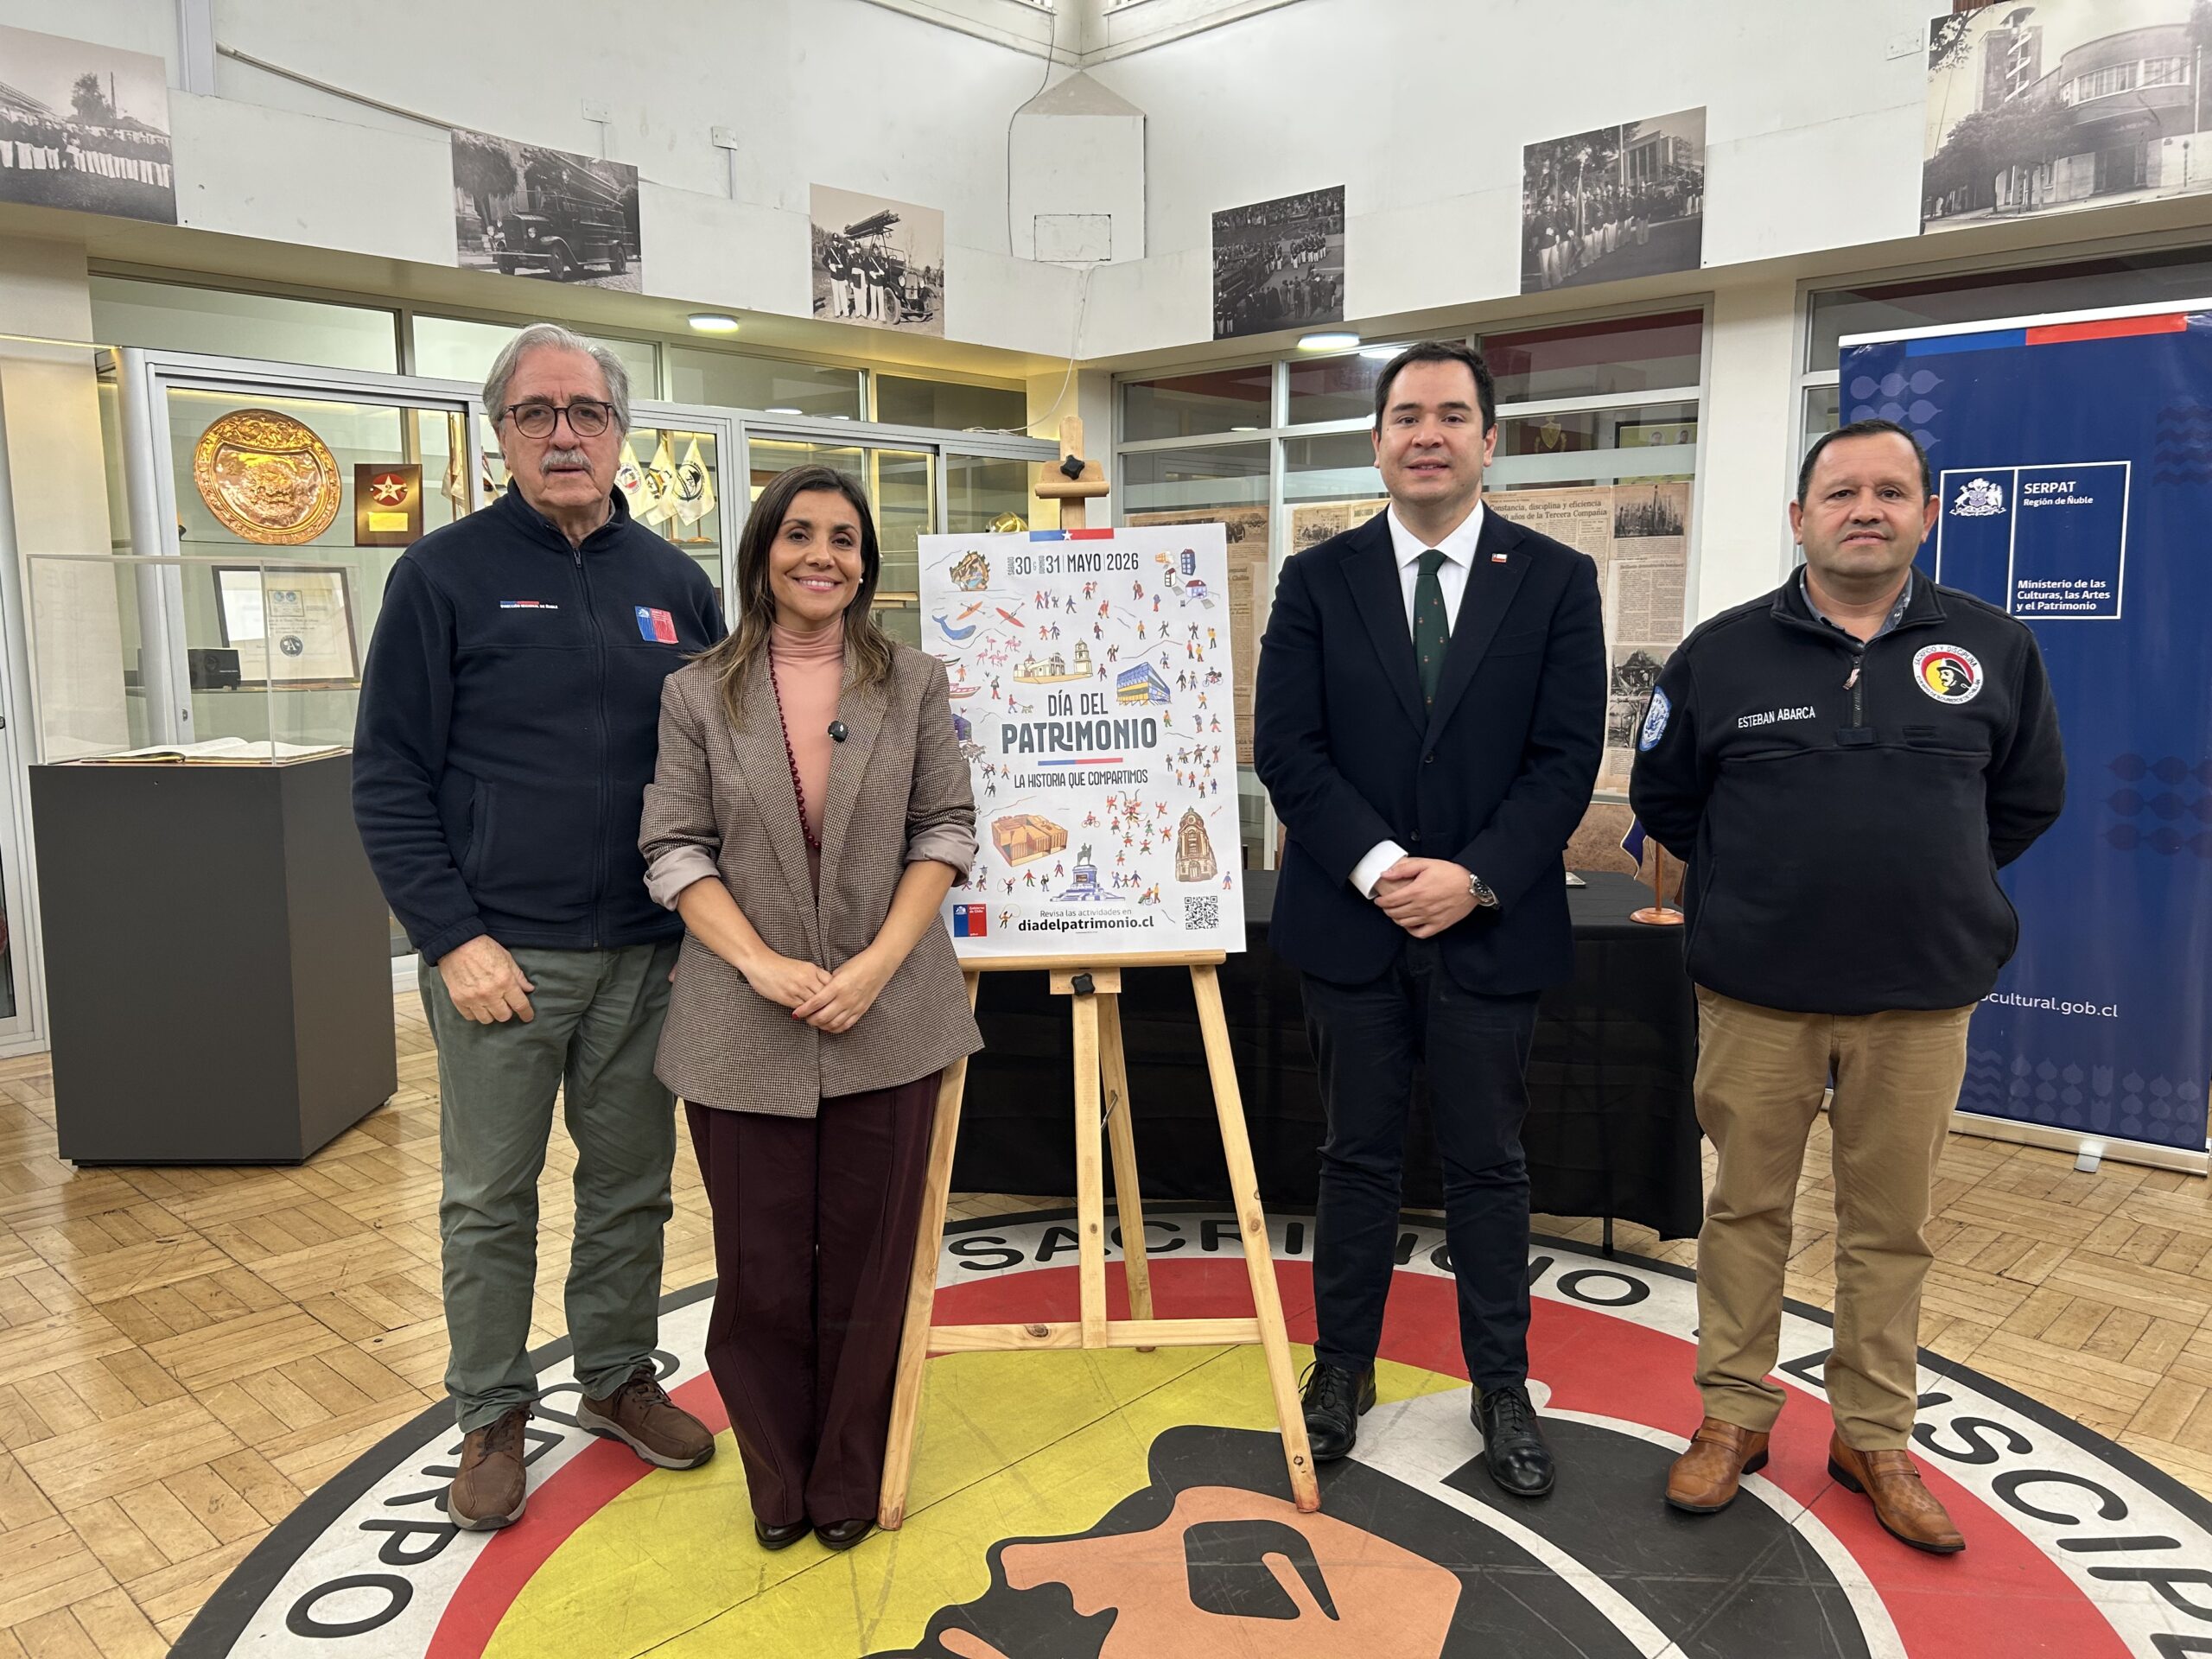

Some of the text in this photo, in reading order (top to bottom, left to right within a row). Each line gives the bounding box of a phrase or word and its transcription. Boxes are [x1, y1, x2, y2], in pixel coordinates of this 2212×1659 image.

[385, 485, 392, 493] 2
[2024, 481, 2076, 494] SERPAT
[2024, 498, 2053, 507] Región
[2067, 495, 2094, 505] Ñuble
[1015, 556, 1032, 575] 30
[1046, 555, 1060, 573] 31
[1067, 553, 1101, 572] MAYO
[1106, 553, 1139, 570] 2026
[2018, 580, 2072, 588] Ministerio
[2090, 579, 2106, 588] las
[2017, 591, 2063, 600] Culturas,
[2065, 590, 2080, 599] las
[2016, 601, 2097, 612] y el Patrimonio
[1947, 646, 1978, 667] DISCIPLINA
[1048, 690, 1109, 716] DÍA DEL
[1738, 706, 1815, 728] ESTEBAN ABARCA
[1001, 718, 1157, 753] PATRIMONIO
[1014, 769, 1148, 788] LA HISTORIA QUE COMPARTIMOS
[1018, 916, 1154, 932] diadelpatrimonio.cl
